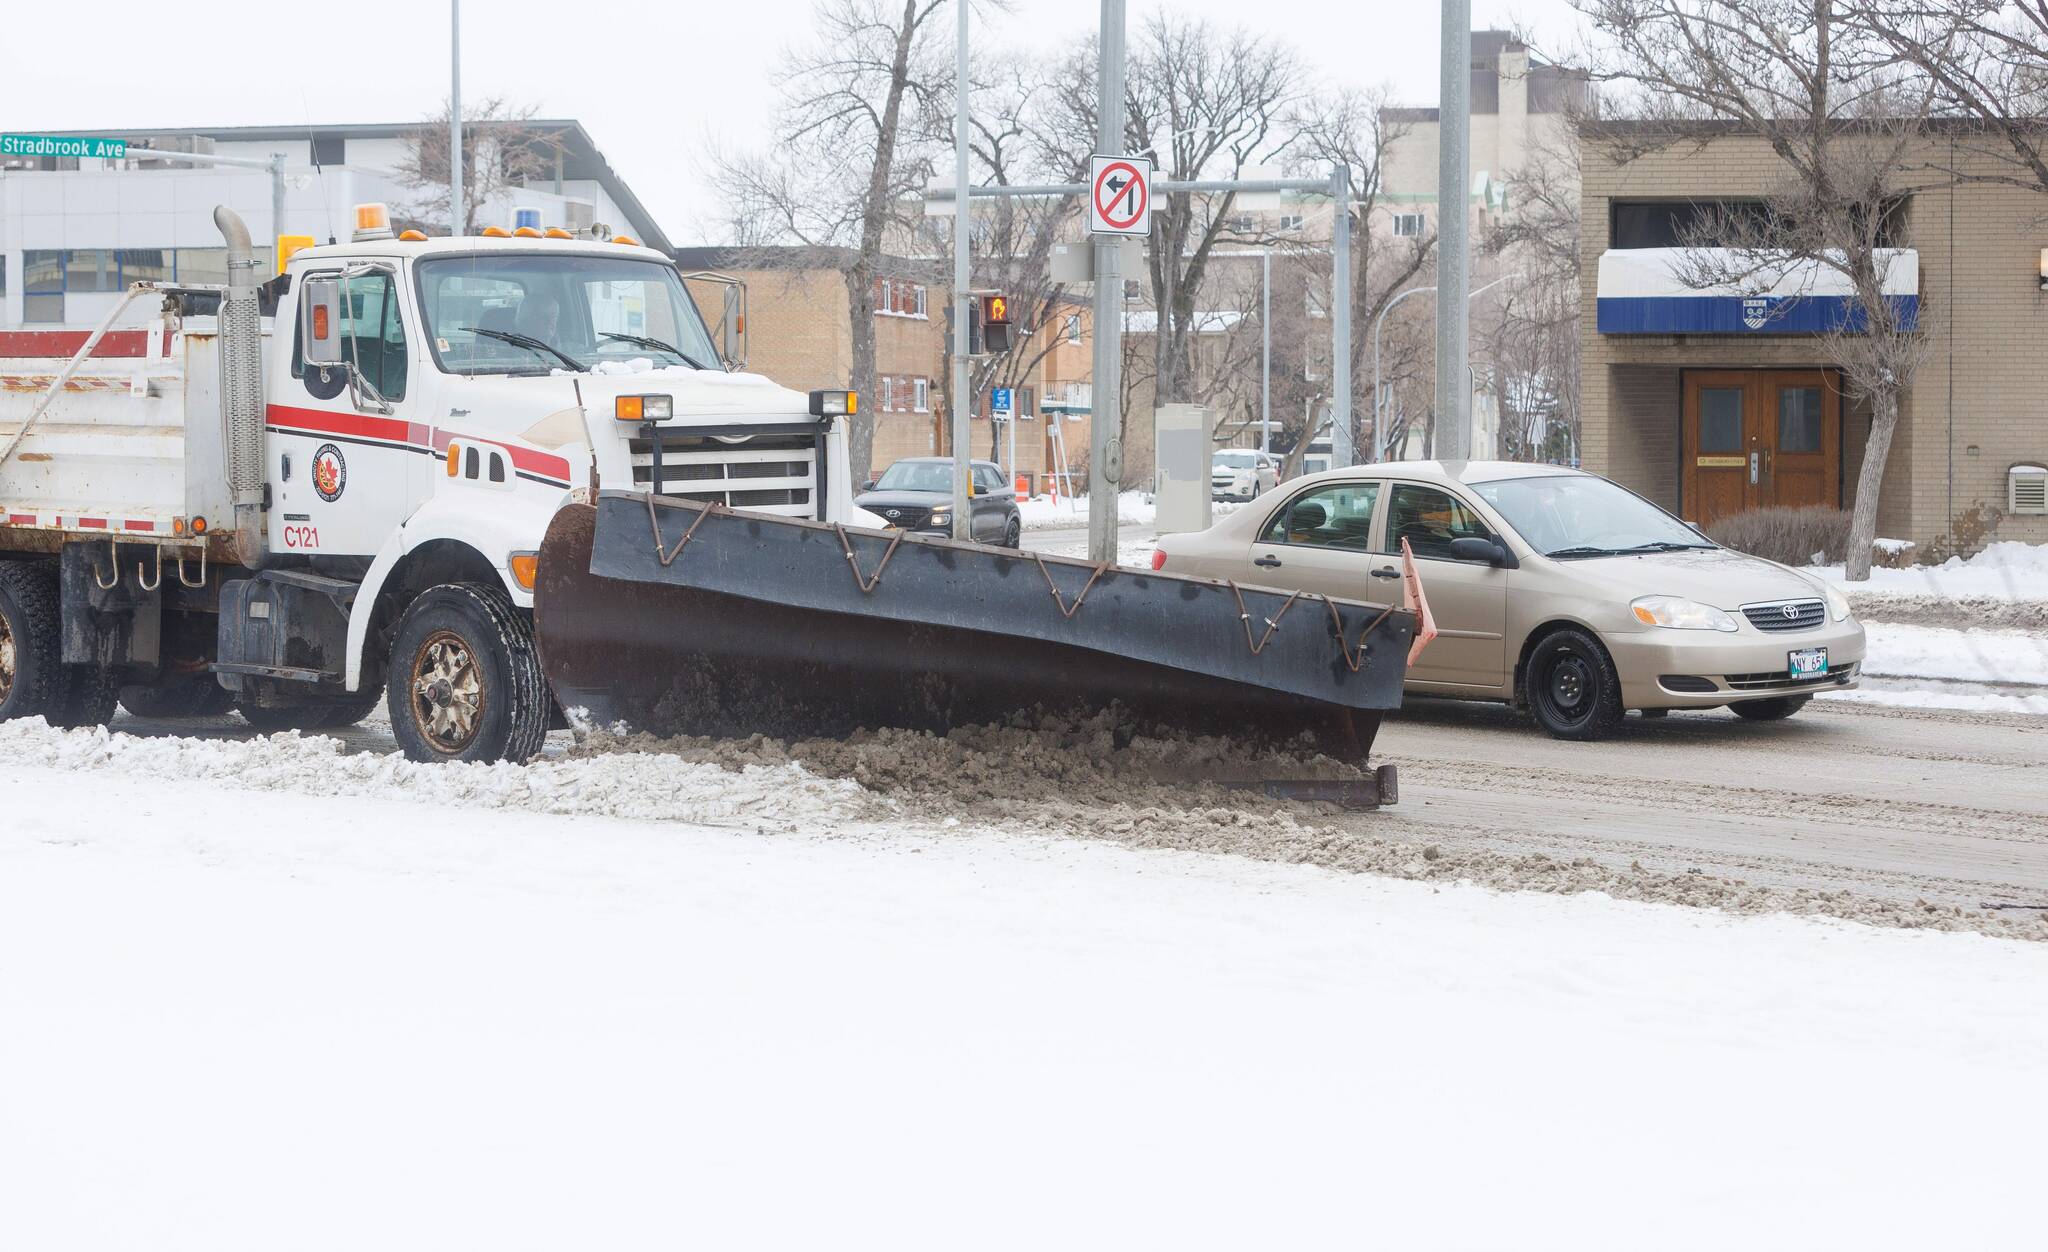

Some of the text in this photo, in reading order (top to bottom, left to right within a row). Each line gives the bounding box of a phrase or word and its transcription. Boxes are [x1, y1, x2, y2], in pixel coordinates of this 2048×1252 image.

[4, 137, 124, 157] Stradbrook Ave
[284, 526, 319, 548] C121
